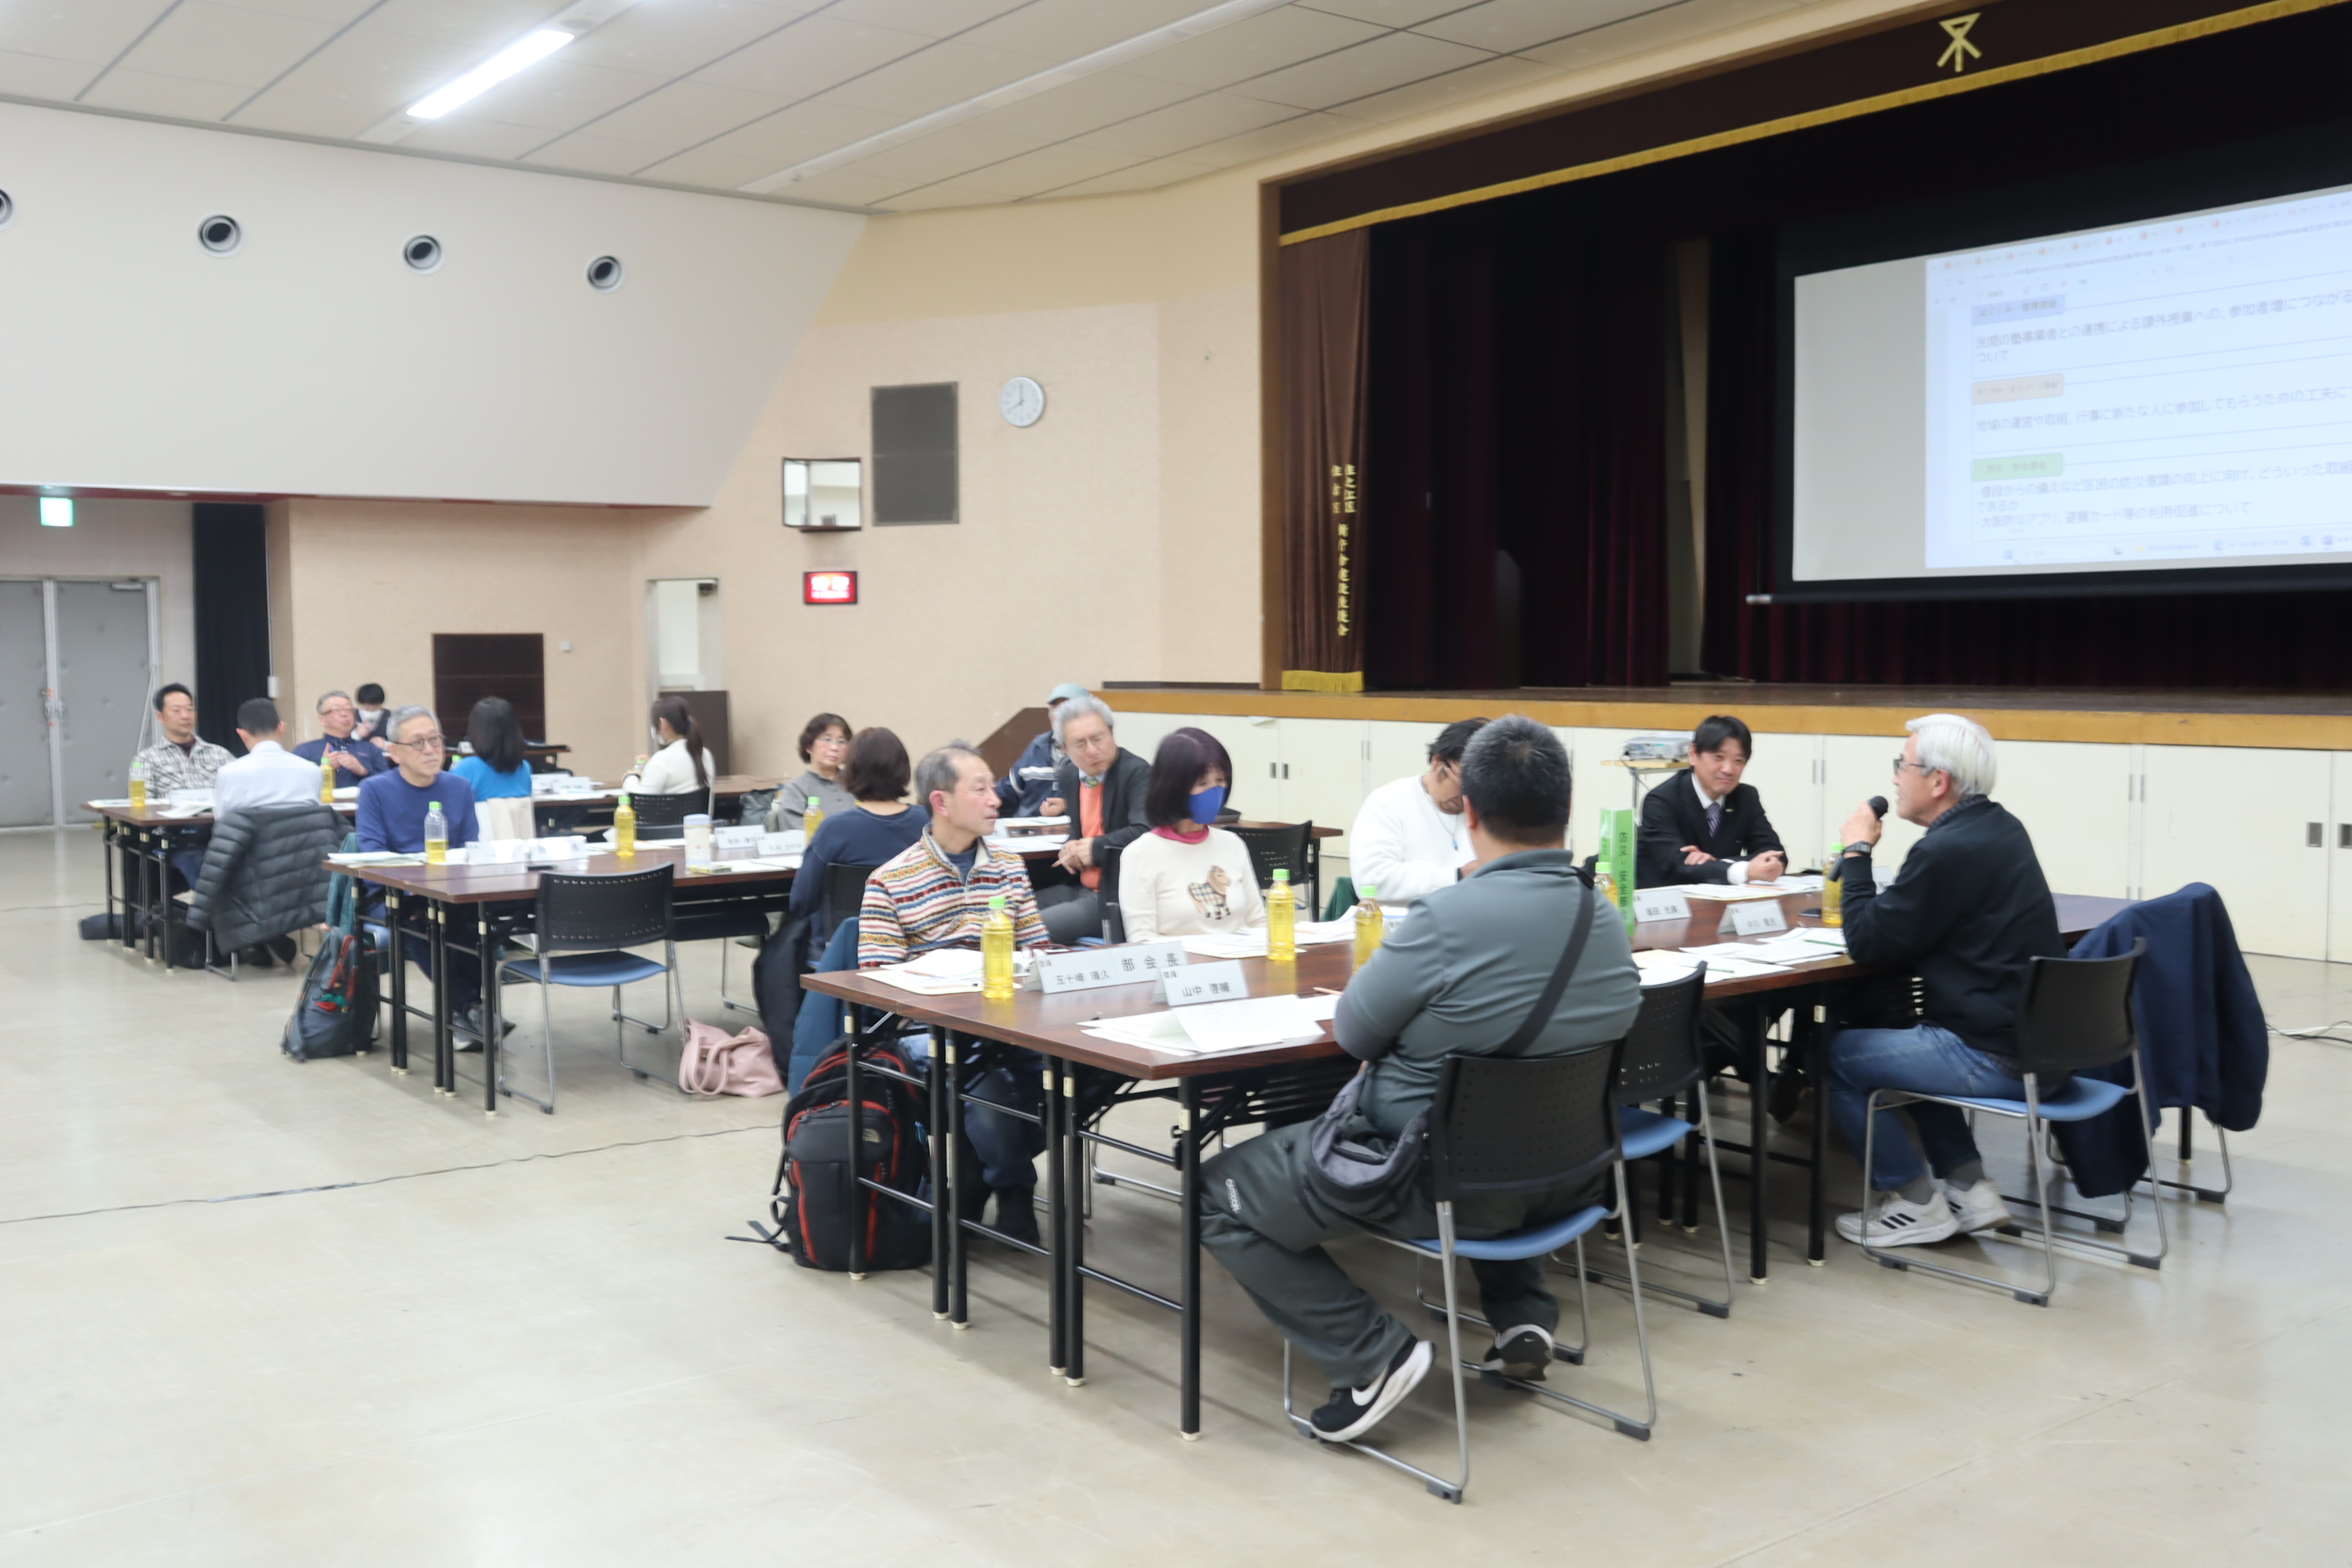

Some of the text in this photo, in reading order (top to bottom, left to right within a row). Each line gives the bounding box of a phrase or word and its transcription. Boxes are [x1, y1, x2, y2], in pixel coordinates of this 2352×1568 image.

[1977, 349, 2009, 363] ついて
[1976, 386, 2352, 432] 地域の運営や取組、行事に新たな人に参加してもらうための工夫に
[1976, 499, 2018, 512] であるか
[1121, 952, 1180, 972] 部会長
[1182, 985, 1202, 997] 山中
